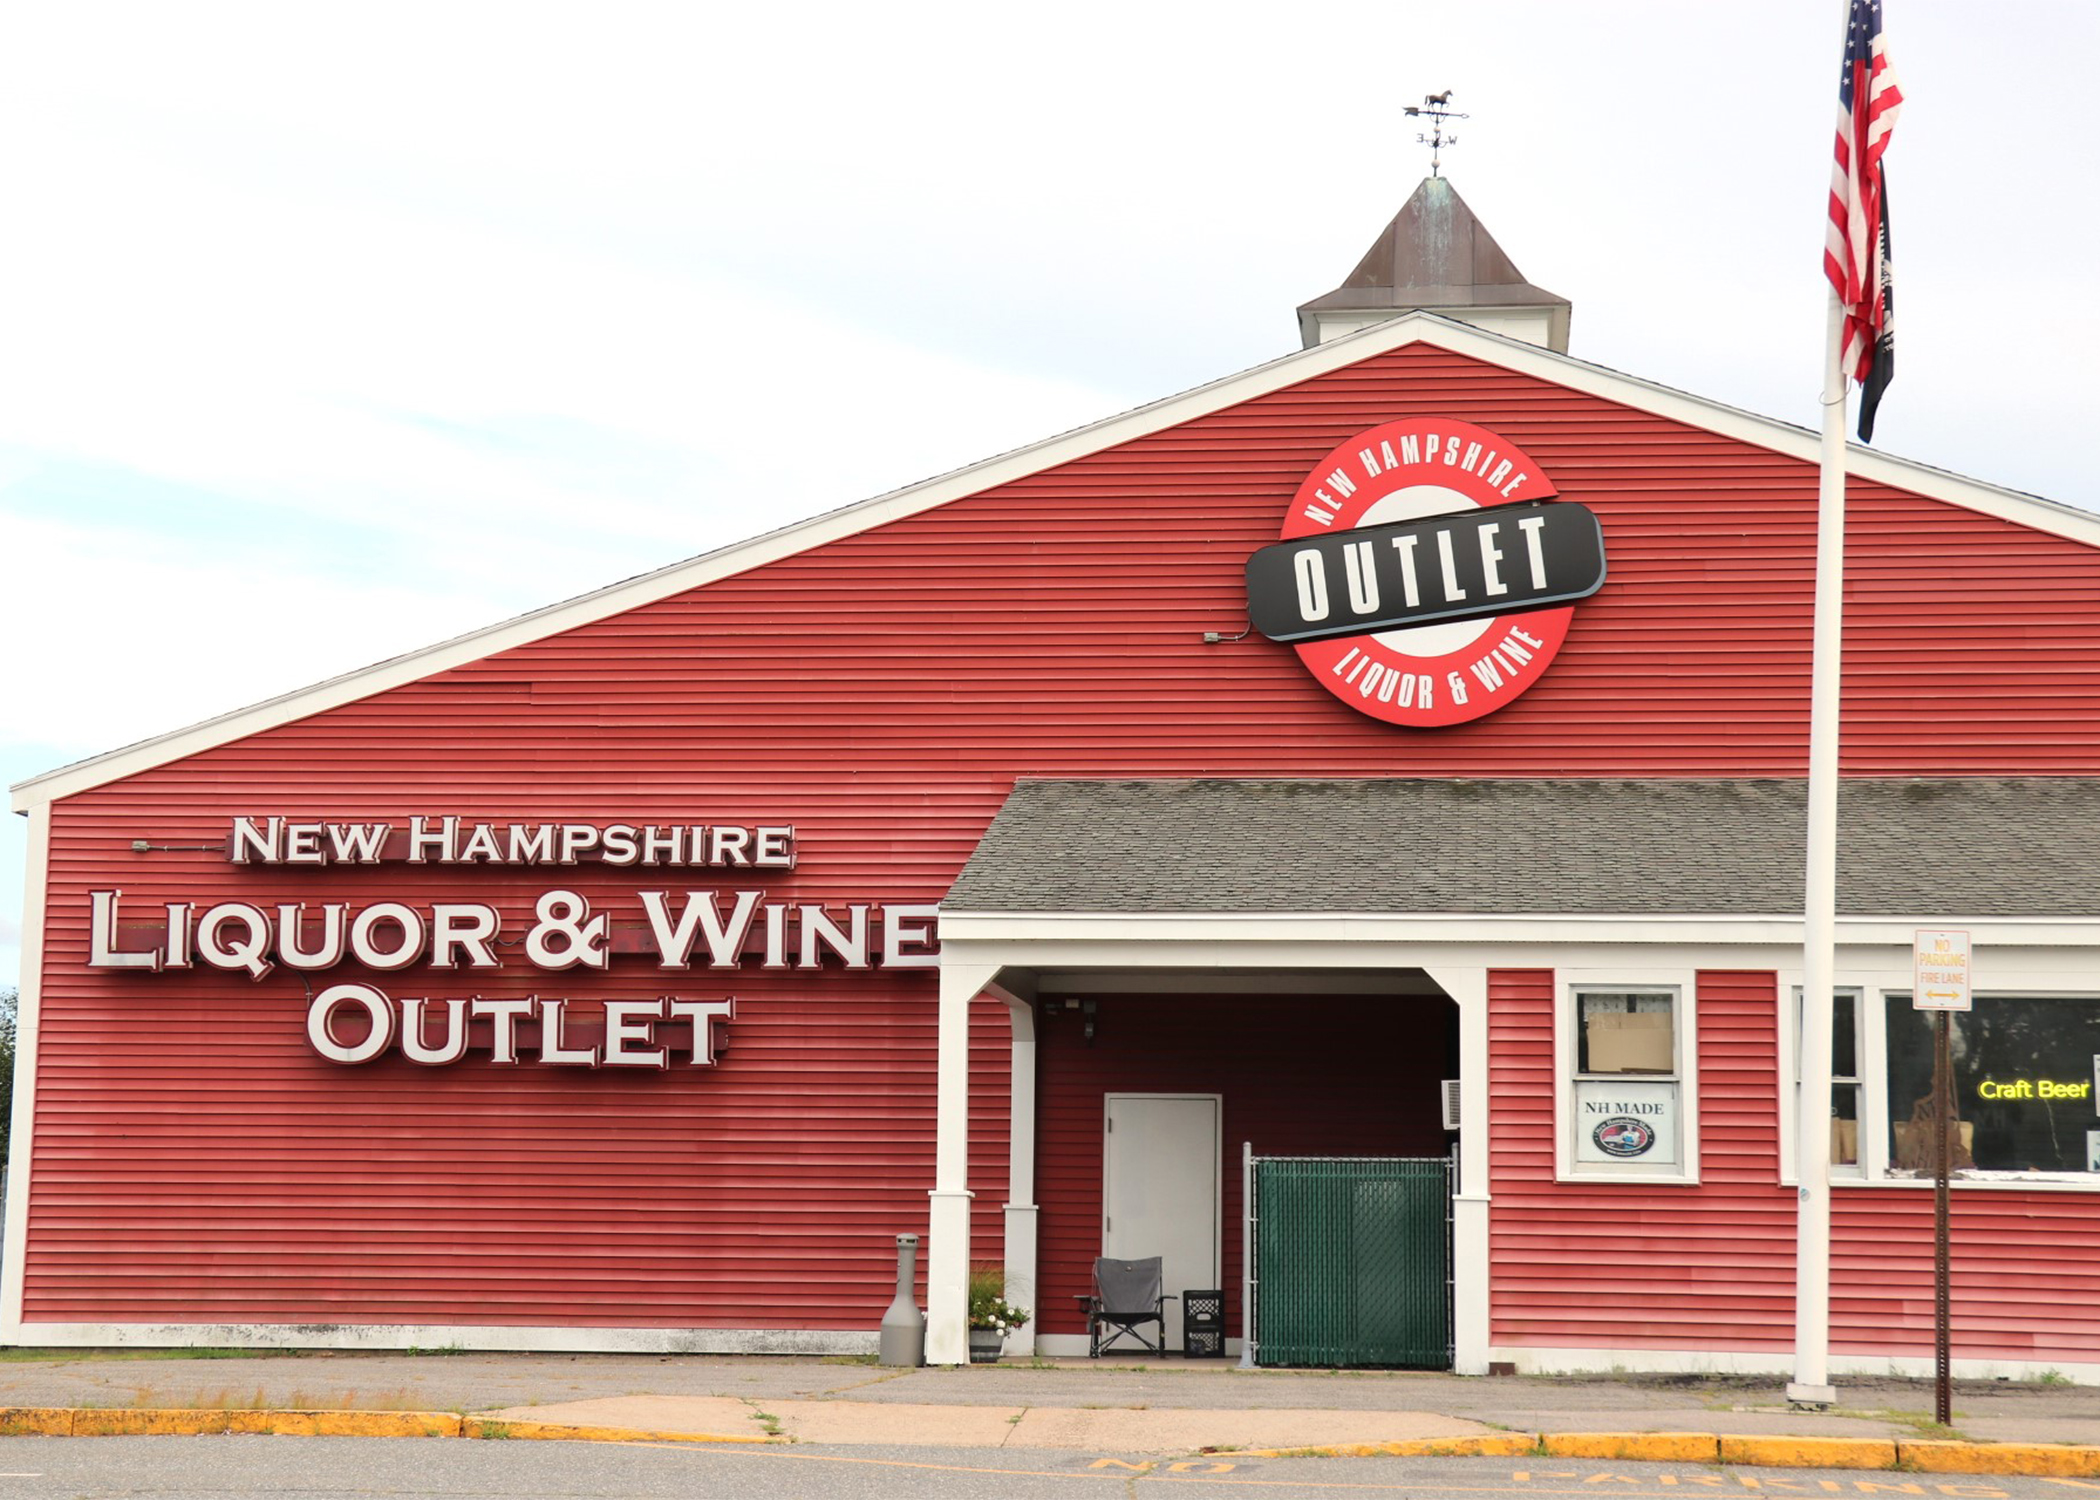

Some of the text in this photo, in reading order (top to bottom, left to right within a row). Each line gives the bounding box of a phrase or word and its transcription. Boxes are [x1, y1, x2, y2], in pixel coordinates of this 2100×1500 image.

[1304, 433, 1528, 526] NEW HAMPSHIRE
[1293, 516, 1548, 622] OUTLET
[1332, 625, 1544, 710] LIQUOR & WINE
[231, 815, 796, 870] NEW HAMPSHIRE
[88, 889, 941, 981] LIQUOR & WINE
[1934, 939, 1951, 952] NO
[1919, 953, 1966, 968] PARKING
[1920, 972, 1965, 984] FIRE LANE
[306, 982, 736, 1070] OUTLET
[1585, 1101, 1664, 1115] NH MADE
[1979, 1079, 2090, 1099] Craft Beer
[1087, 1457, 2011, 1499] NO PARKING
